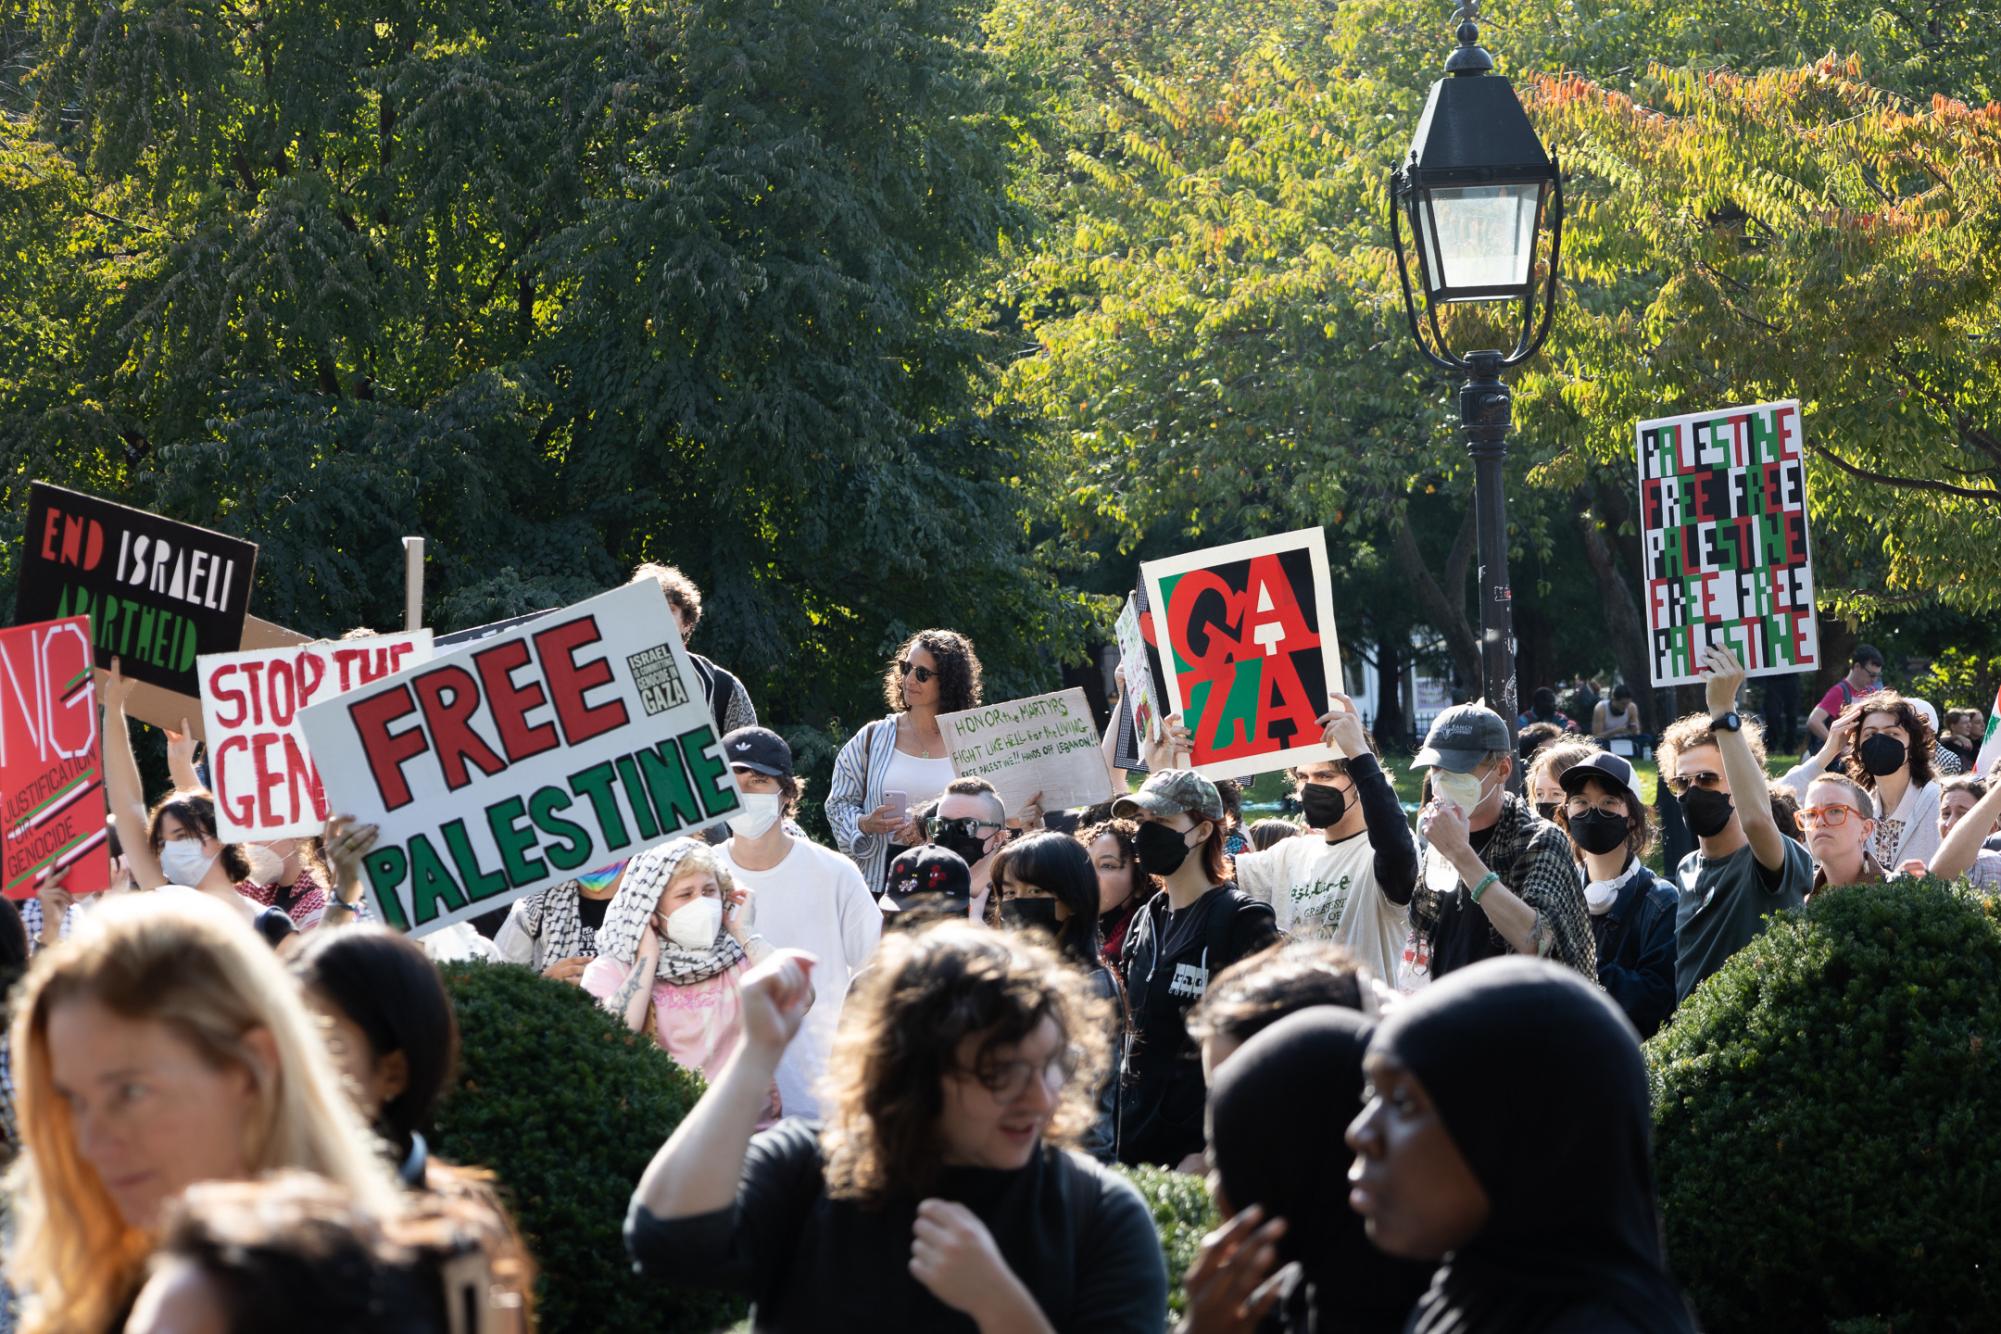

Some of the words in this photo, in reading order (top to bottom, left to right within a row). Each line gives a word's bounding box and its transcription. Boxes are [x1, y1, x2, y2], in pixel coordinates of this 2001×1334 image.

[1642, 407, 1798, 480] PALESTINE
[1643, 471, 1715, 530] FREE
[1728, 459, 1802, 519] FREE
[41, 507, 105, 571] END
[116, 530, 234, 612] ISRAELI
[1646, 510, 1807, 580] PALESTINE
[1650, 571, 1722, 629] FREE
[1736, 561, 1809, 619] FREE
[209, 651, 326, 729] STOP
[628, 645, 671, 669] ISRAEL
[347, 614, 631, 813] FREE
[641, 678, 688, 714] GAZA
[954, 709, 1004, 736] HONOR
[1018, 698, 1069, 720] MARTYRS
[952, 745, 982, 766] FIGHT
[985, 737, 1004, 756] LIKE
[1003, 730, 1026, 750] HELL
[1055, 718, 1089, 737] LIVING
[4, 748, 97, 824] JUSTIFICATION
[5, 817, 31, 850] FOR
[7, 816, 77, 878] GENOCIDE
[361, 723, 741, 932] PALESTINE
